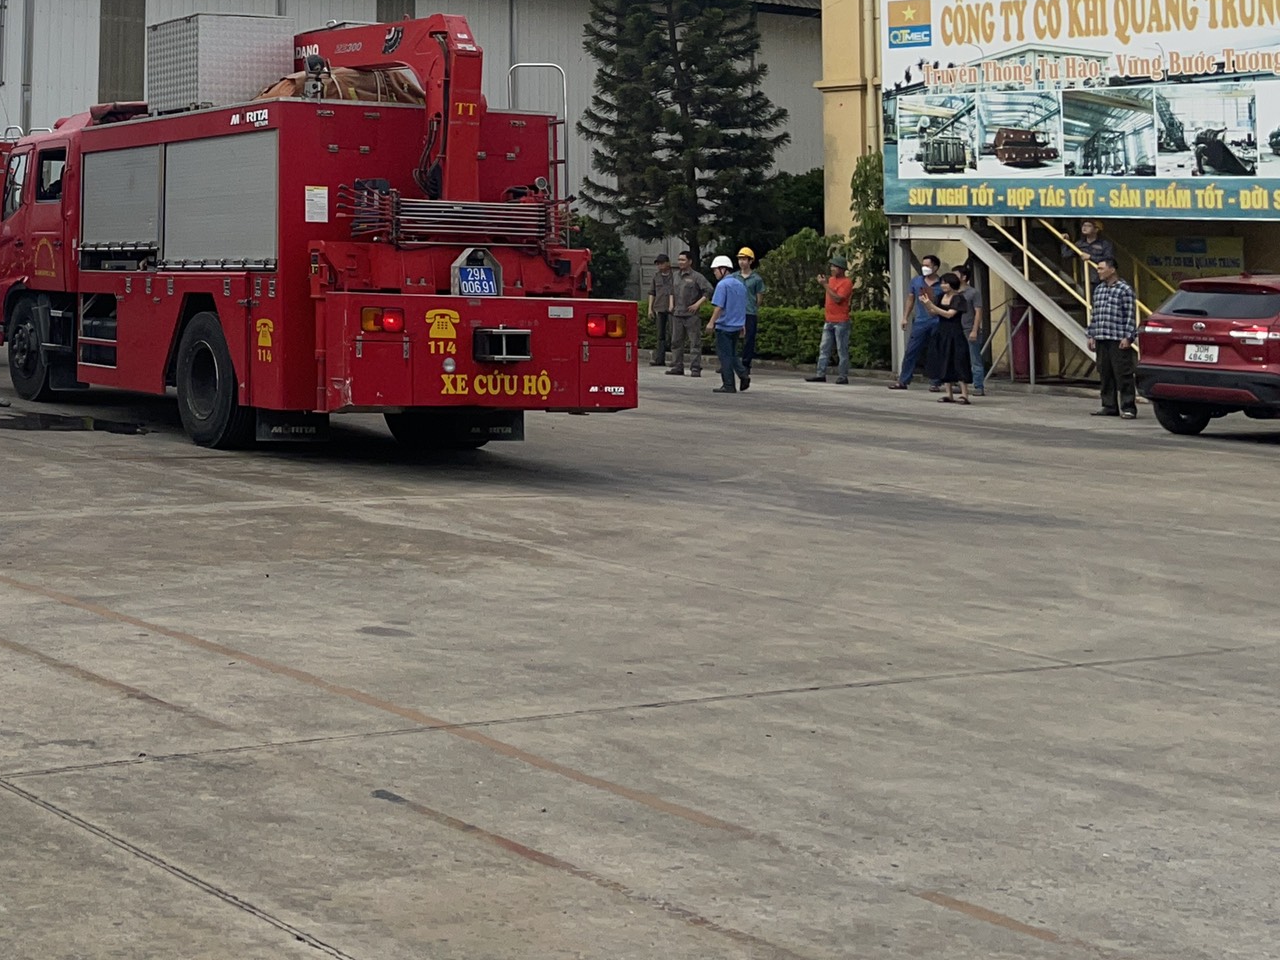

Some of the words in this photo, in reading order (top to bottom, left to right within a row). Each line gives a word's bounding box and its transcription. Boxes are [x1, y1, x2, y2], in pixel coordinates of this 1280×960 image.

[1000, 0, 1028, 42] TY
[923, 58, 978, 88] Truyền
[982, 58, 1033, 85] Thống
[1065, 56, 1099, 80] Hào
[1115, 53, 1164, 82] Vững
[1168, 50, 1218, 75] Bước
[454, 102, 478, 116] TT
[908, 187, 934, 206] SUY
[936, 185, 968, 206] NGHĨ
[971, 182, 995, 206] TỐT
[1007, 187, 1035, 211] HỢP
[1038, 185, 1065, 207] TÁC
[1069, 182, 1095, 208] TỐT
[1109, 183, 1141, 208] SẢN
[1145, 182, 1192, 209] PHẨM
[1195, 183, 1224, 209] TỐT
[1239, 185, 1269, 209] ĐỜI
[467, 268, 487, 281] 29A
[257, 348, 272, 362] 114
[428, 341, 457, 355] 114
[440, 374, 468, 395] XE
[473, 370, 519, 395] CỨU
[523, 369, 552, 400] HỘ
